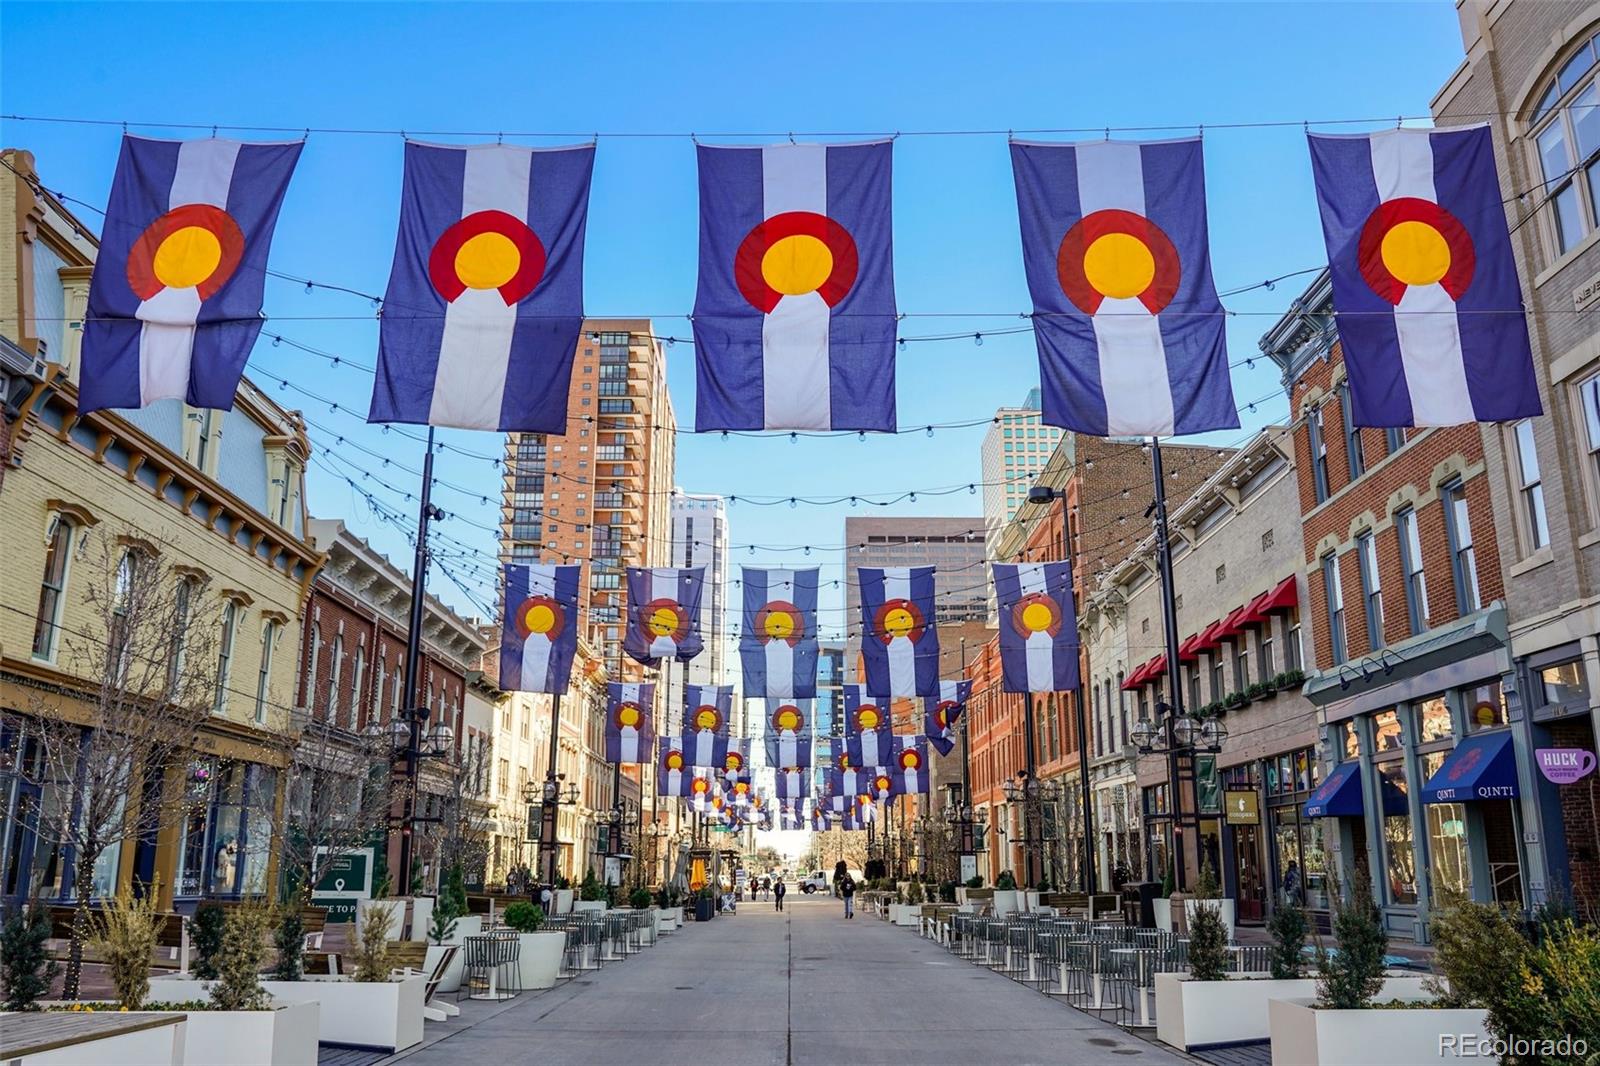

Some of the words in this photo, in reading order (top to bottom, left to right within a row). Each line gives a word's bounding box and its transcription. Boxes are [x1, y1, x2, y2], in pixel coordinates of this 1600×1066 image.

[1543, 752, 1578, 766] HUCK
[1436, 788, 1456, 801] QINTI
[1478, 786, 1514, 798] QINTI
[336, 904, 349, 913] TO
